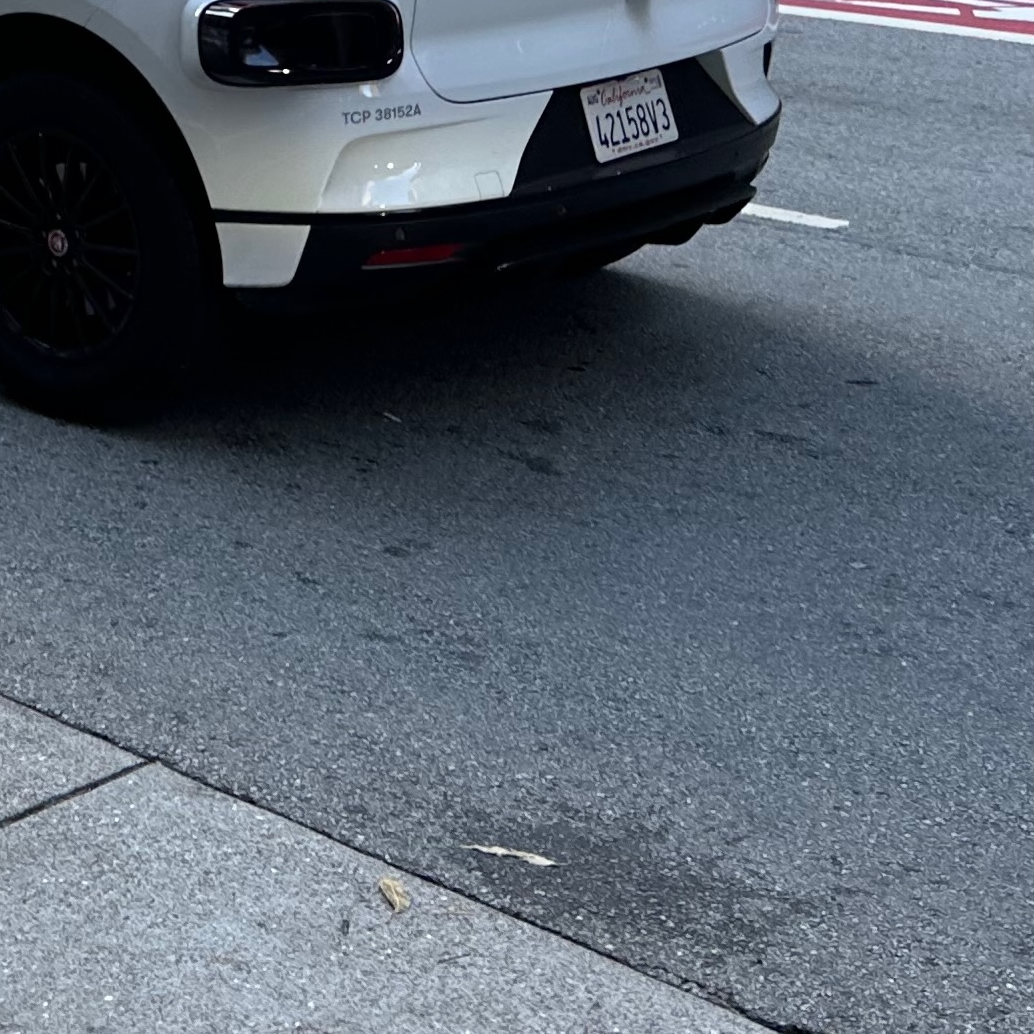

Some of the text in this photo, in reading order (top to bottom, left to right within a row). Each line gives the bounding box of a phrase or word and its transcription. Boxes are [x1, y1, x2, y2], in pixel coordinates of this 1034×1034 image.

[342, 103, 421, 125] TCP 38152A
[596, 98, 670, 148] 42158V3
